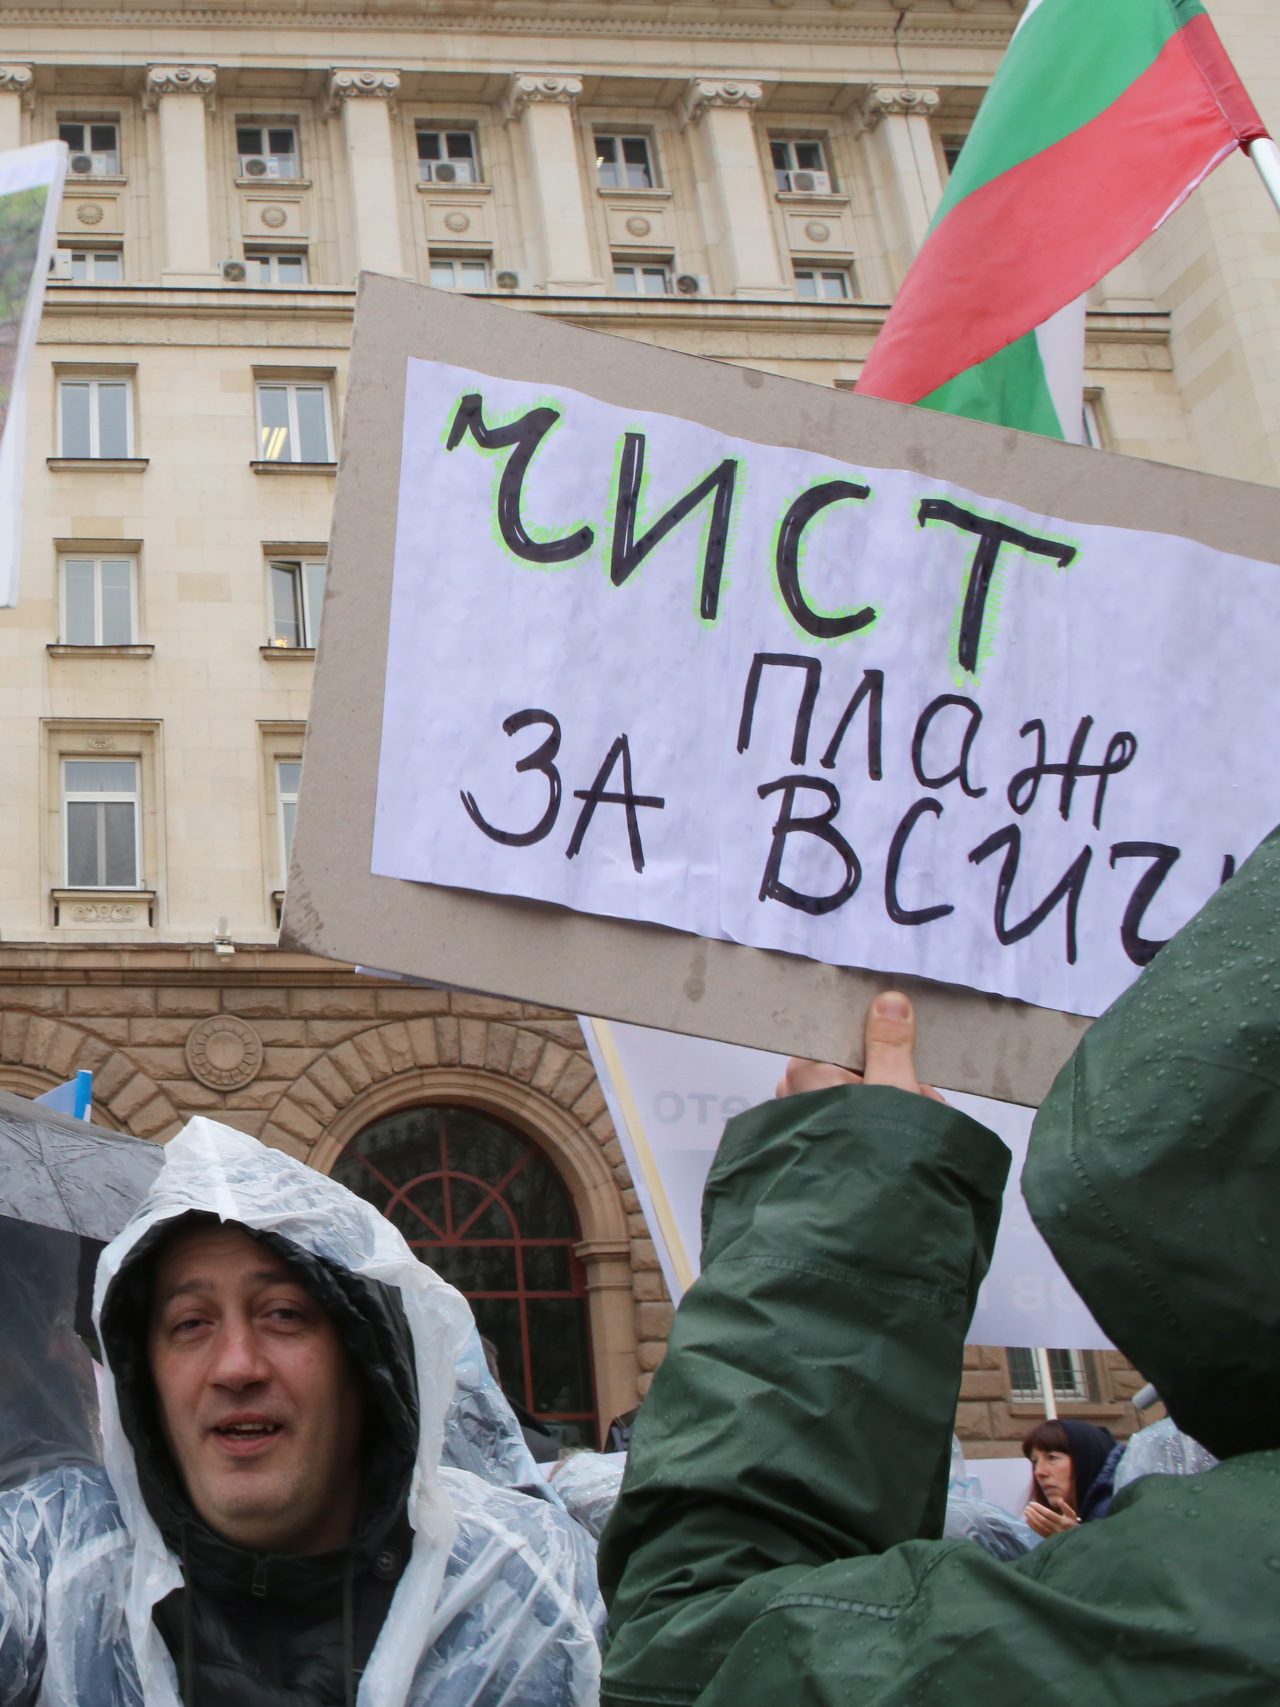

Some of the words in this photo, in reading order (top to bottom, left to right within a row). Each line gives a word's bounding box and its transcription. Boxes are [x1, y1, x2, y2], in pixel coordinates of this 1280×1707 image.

[446, 393, 1078, 675] ЧИСТ
[460, 708, 666, 873] ЗА
[757, 774, 1236, 967] ВСИЧ
